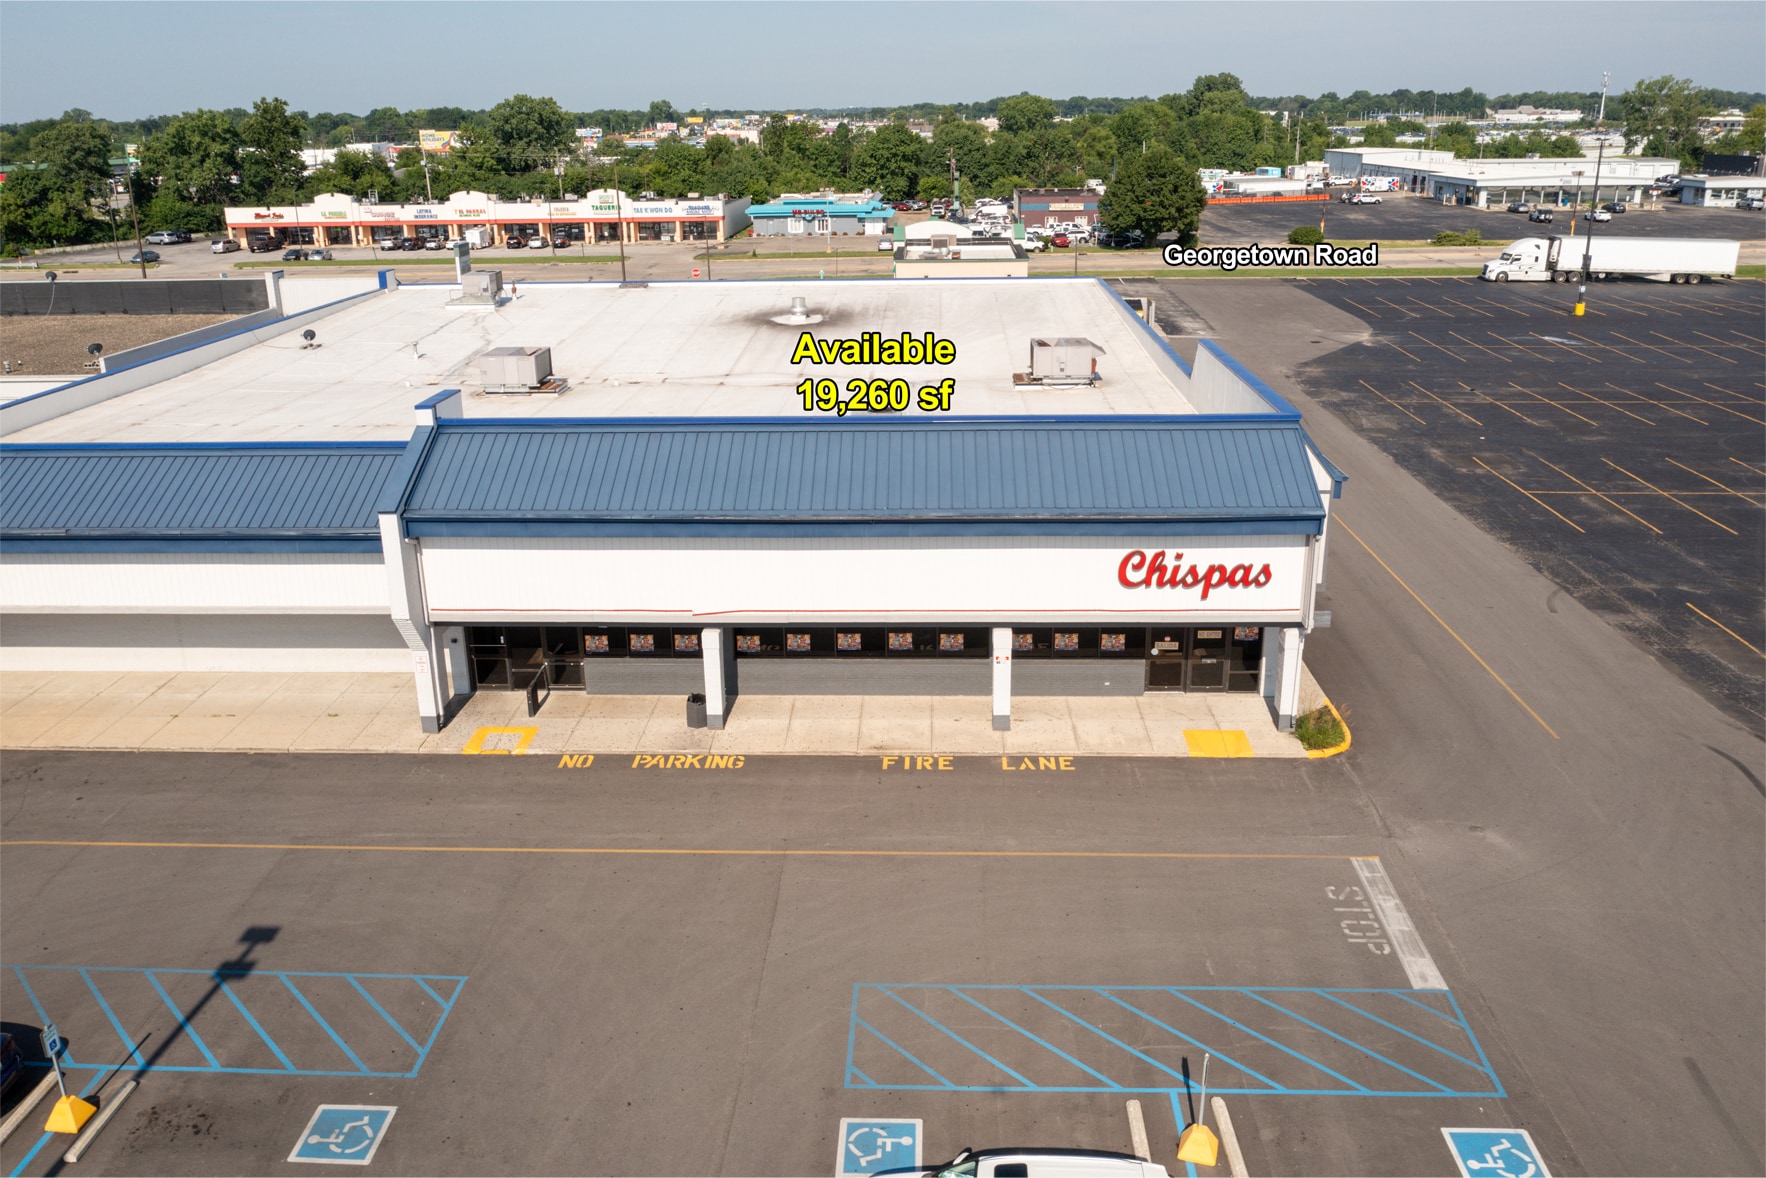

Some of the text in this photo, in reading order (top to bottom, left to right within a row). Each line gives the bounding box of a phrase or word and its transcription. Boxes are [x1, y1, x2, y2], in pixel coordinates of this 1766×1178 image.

[1118, 550, 1272, 601] Chispas
[557, 755, 1076, 771] NO PARKING FIRE LANE
[1325, 886, 1391, 955] STOP
